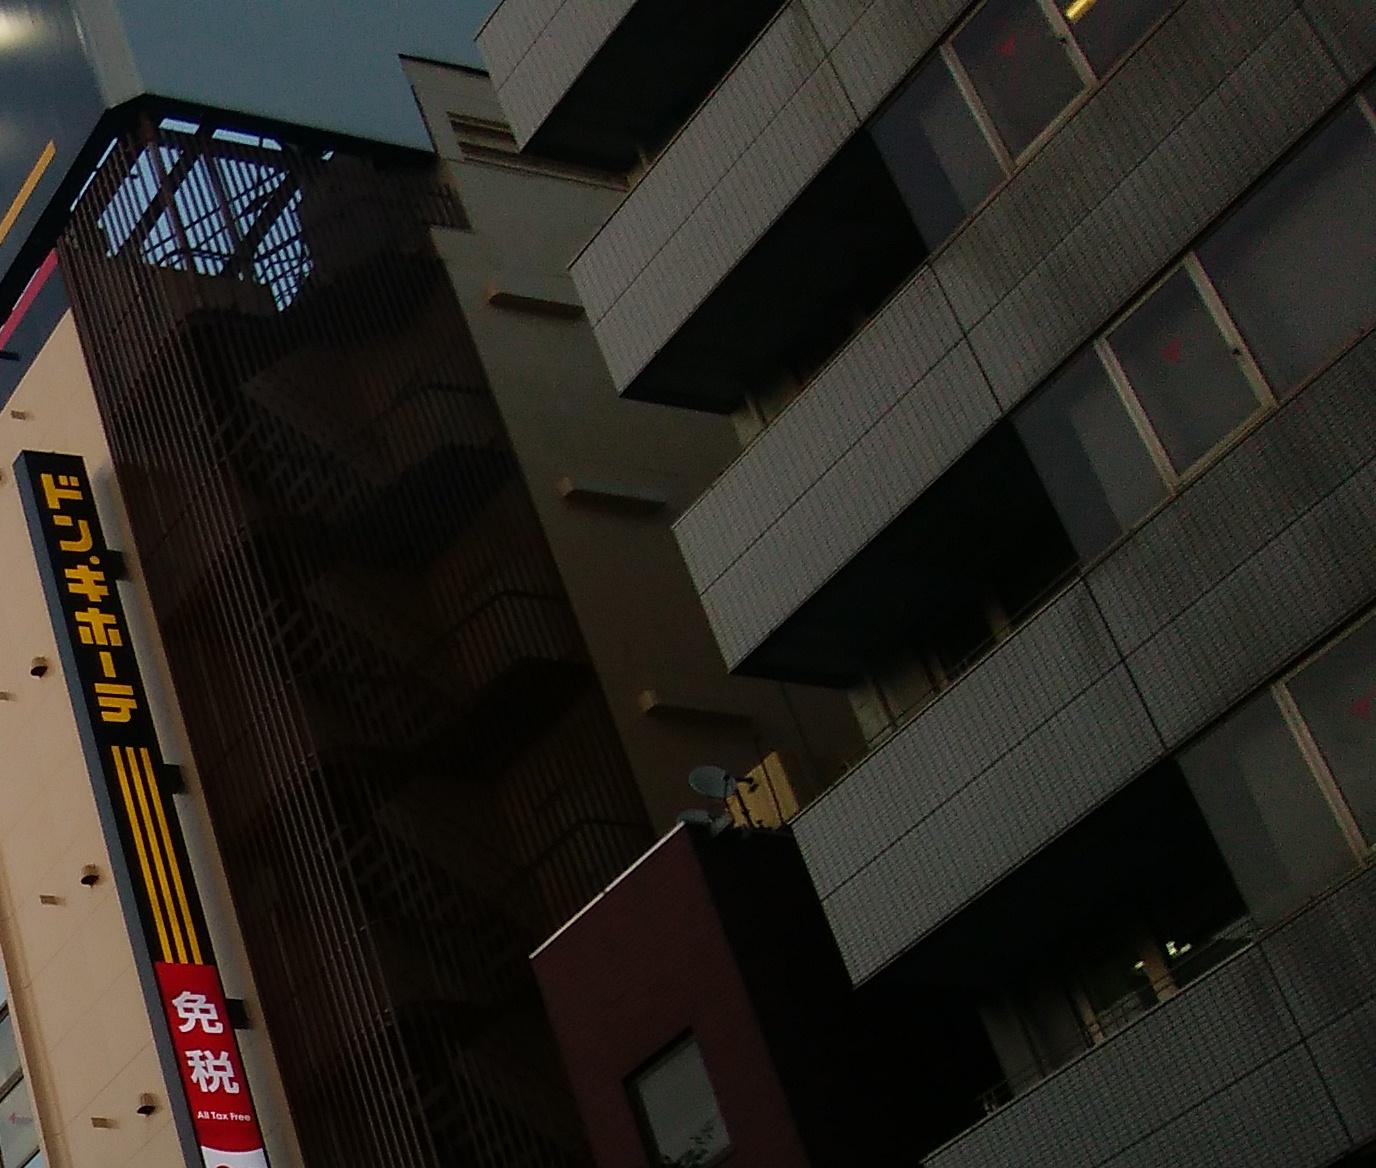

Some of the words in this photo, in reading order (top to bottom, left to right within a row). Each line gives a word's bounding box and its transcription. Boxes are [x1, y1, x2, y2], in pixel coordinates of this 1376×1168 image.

[172, 990, 240, 1094] 免税
[197, 1110, 209, 1119] All
[211, 1111, 228, 1120] Tax
[230, 1112, 251, 1121] Free
